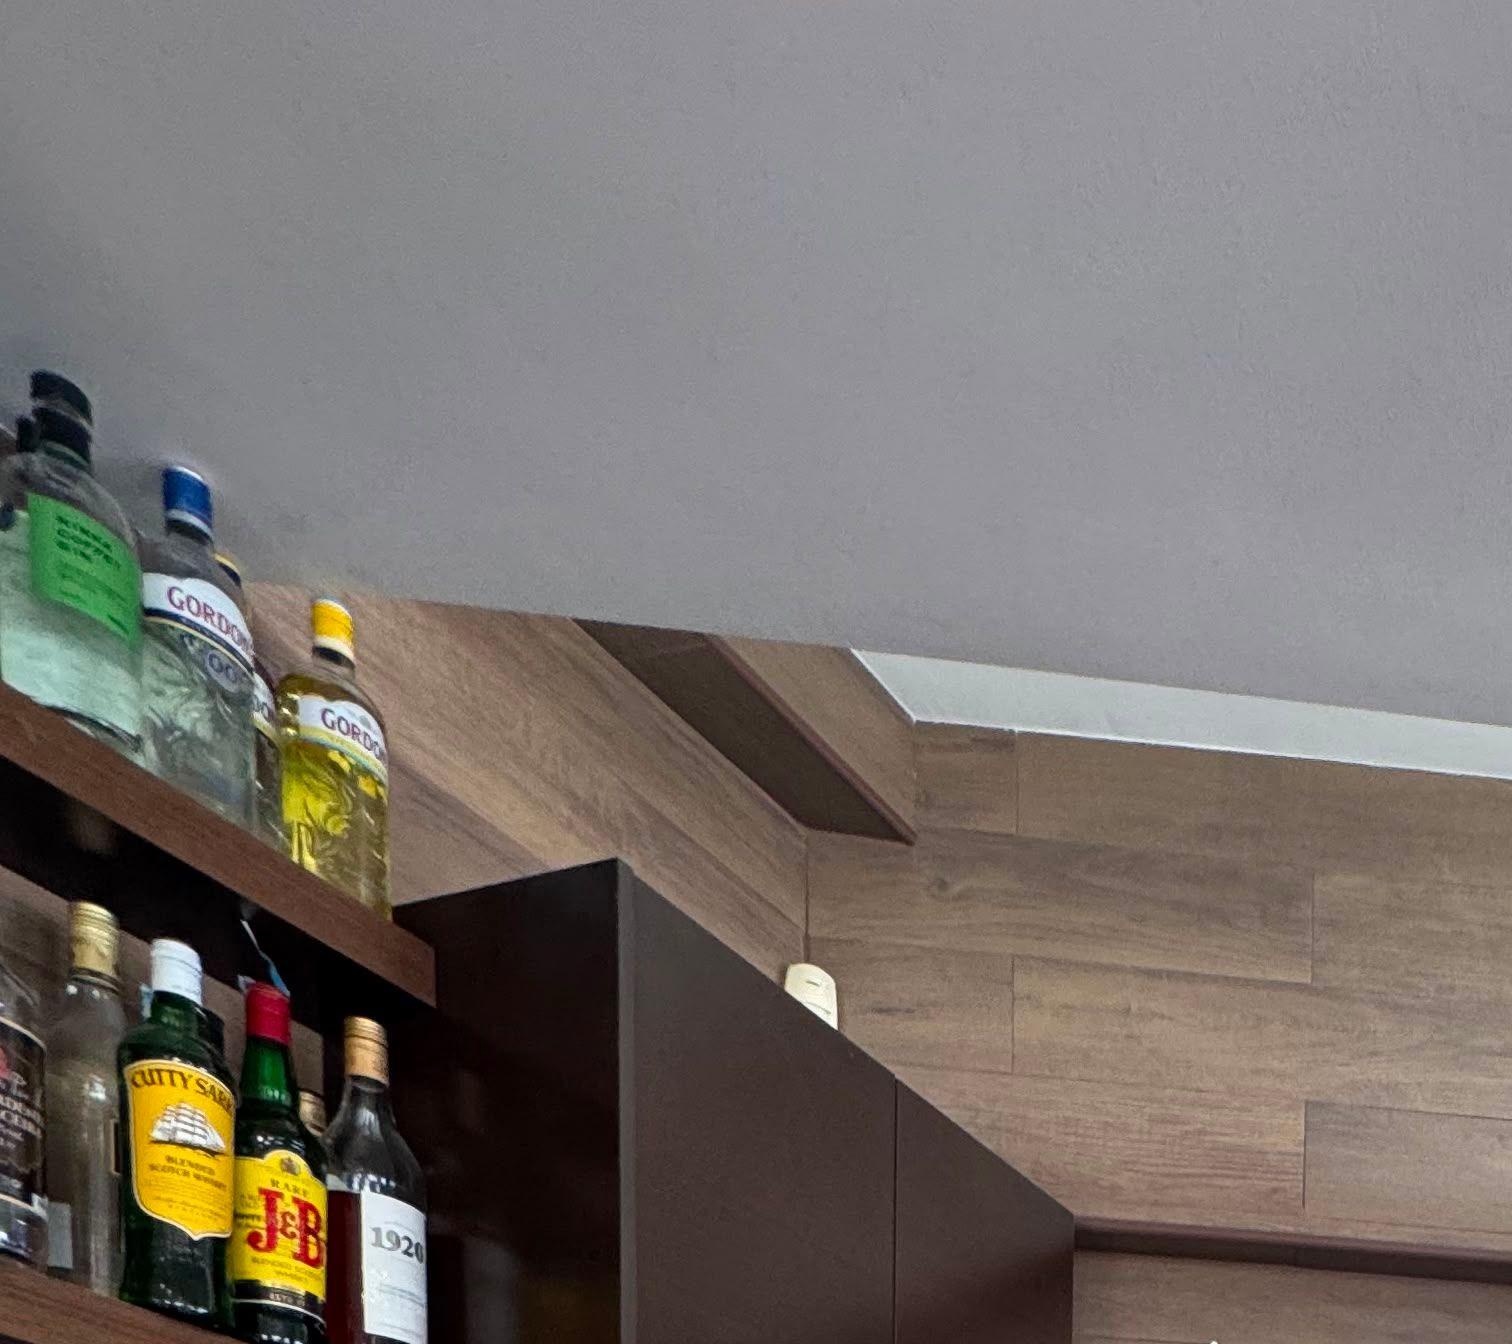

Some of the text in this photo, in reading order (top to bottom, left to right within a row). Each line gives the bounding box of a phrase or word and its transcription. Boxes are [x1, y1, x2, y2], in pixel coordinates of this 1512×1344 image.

[131, 1068, 193, 1090] CUTTY
[247, 1186, 324, 1270] J&B
[370, 1226, 425, 1265] 1920
